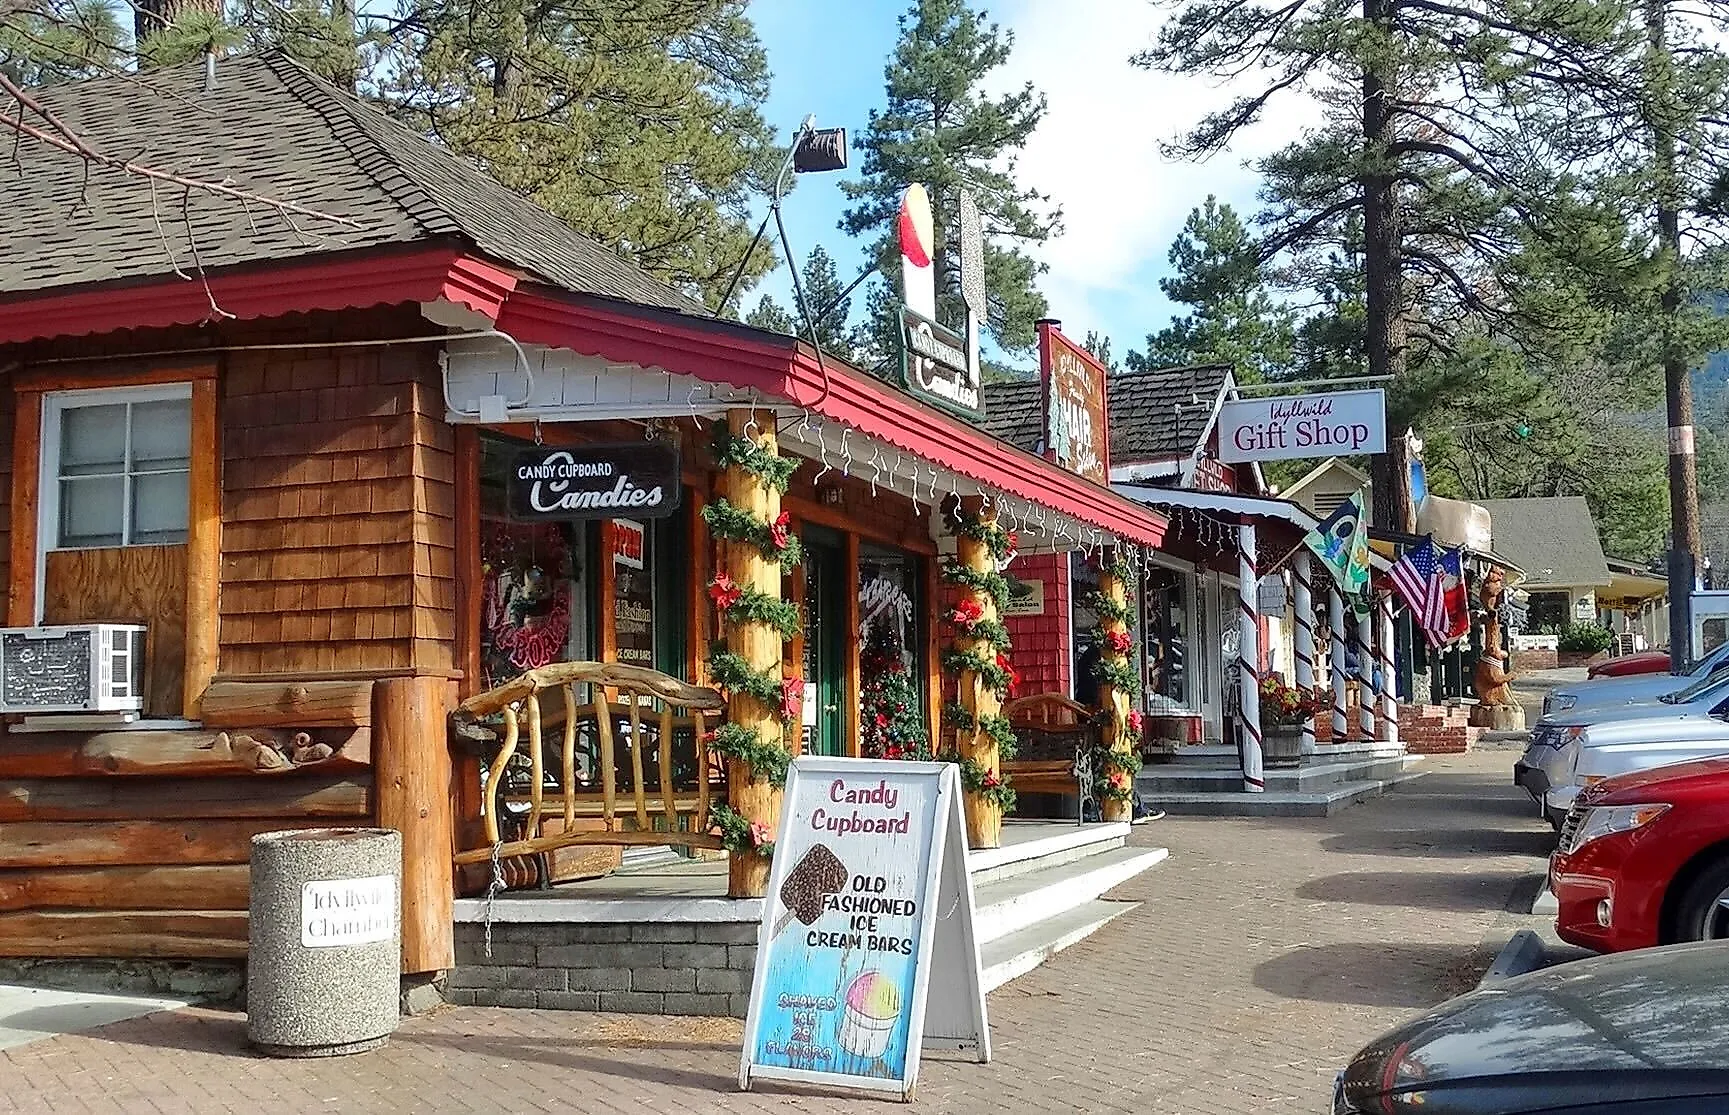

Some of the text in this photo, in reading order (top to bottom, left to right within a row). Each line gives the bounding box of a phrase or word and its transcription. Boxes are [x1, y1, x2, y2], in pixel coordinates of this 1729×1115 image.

[1062, 397, 1092, 448] HAIR
[1270, 399, 1333, 424] Idyllwild
[1234, 419, 1369, 451] Gift Shop
[518, 462, 612, 479] CANDY CUPBOARD
[530, 451, 663, 512] Candies
[829, 779, 899, 808] Candy
[811, 808, 910, 836] Cupboard
[852, 875, 887, 893] OLD
[821, 894, 916, 917] FASHIONED
[849, 916, 878, 932] ICE
[806, 931, 913, 955] CREAM BARS
[778, 992, 837, 1011] SHAVED
[793, 1011, 817, 1026] ICE
[765, 1040, 833, 1061] FLAVORS
